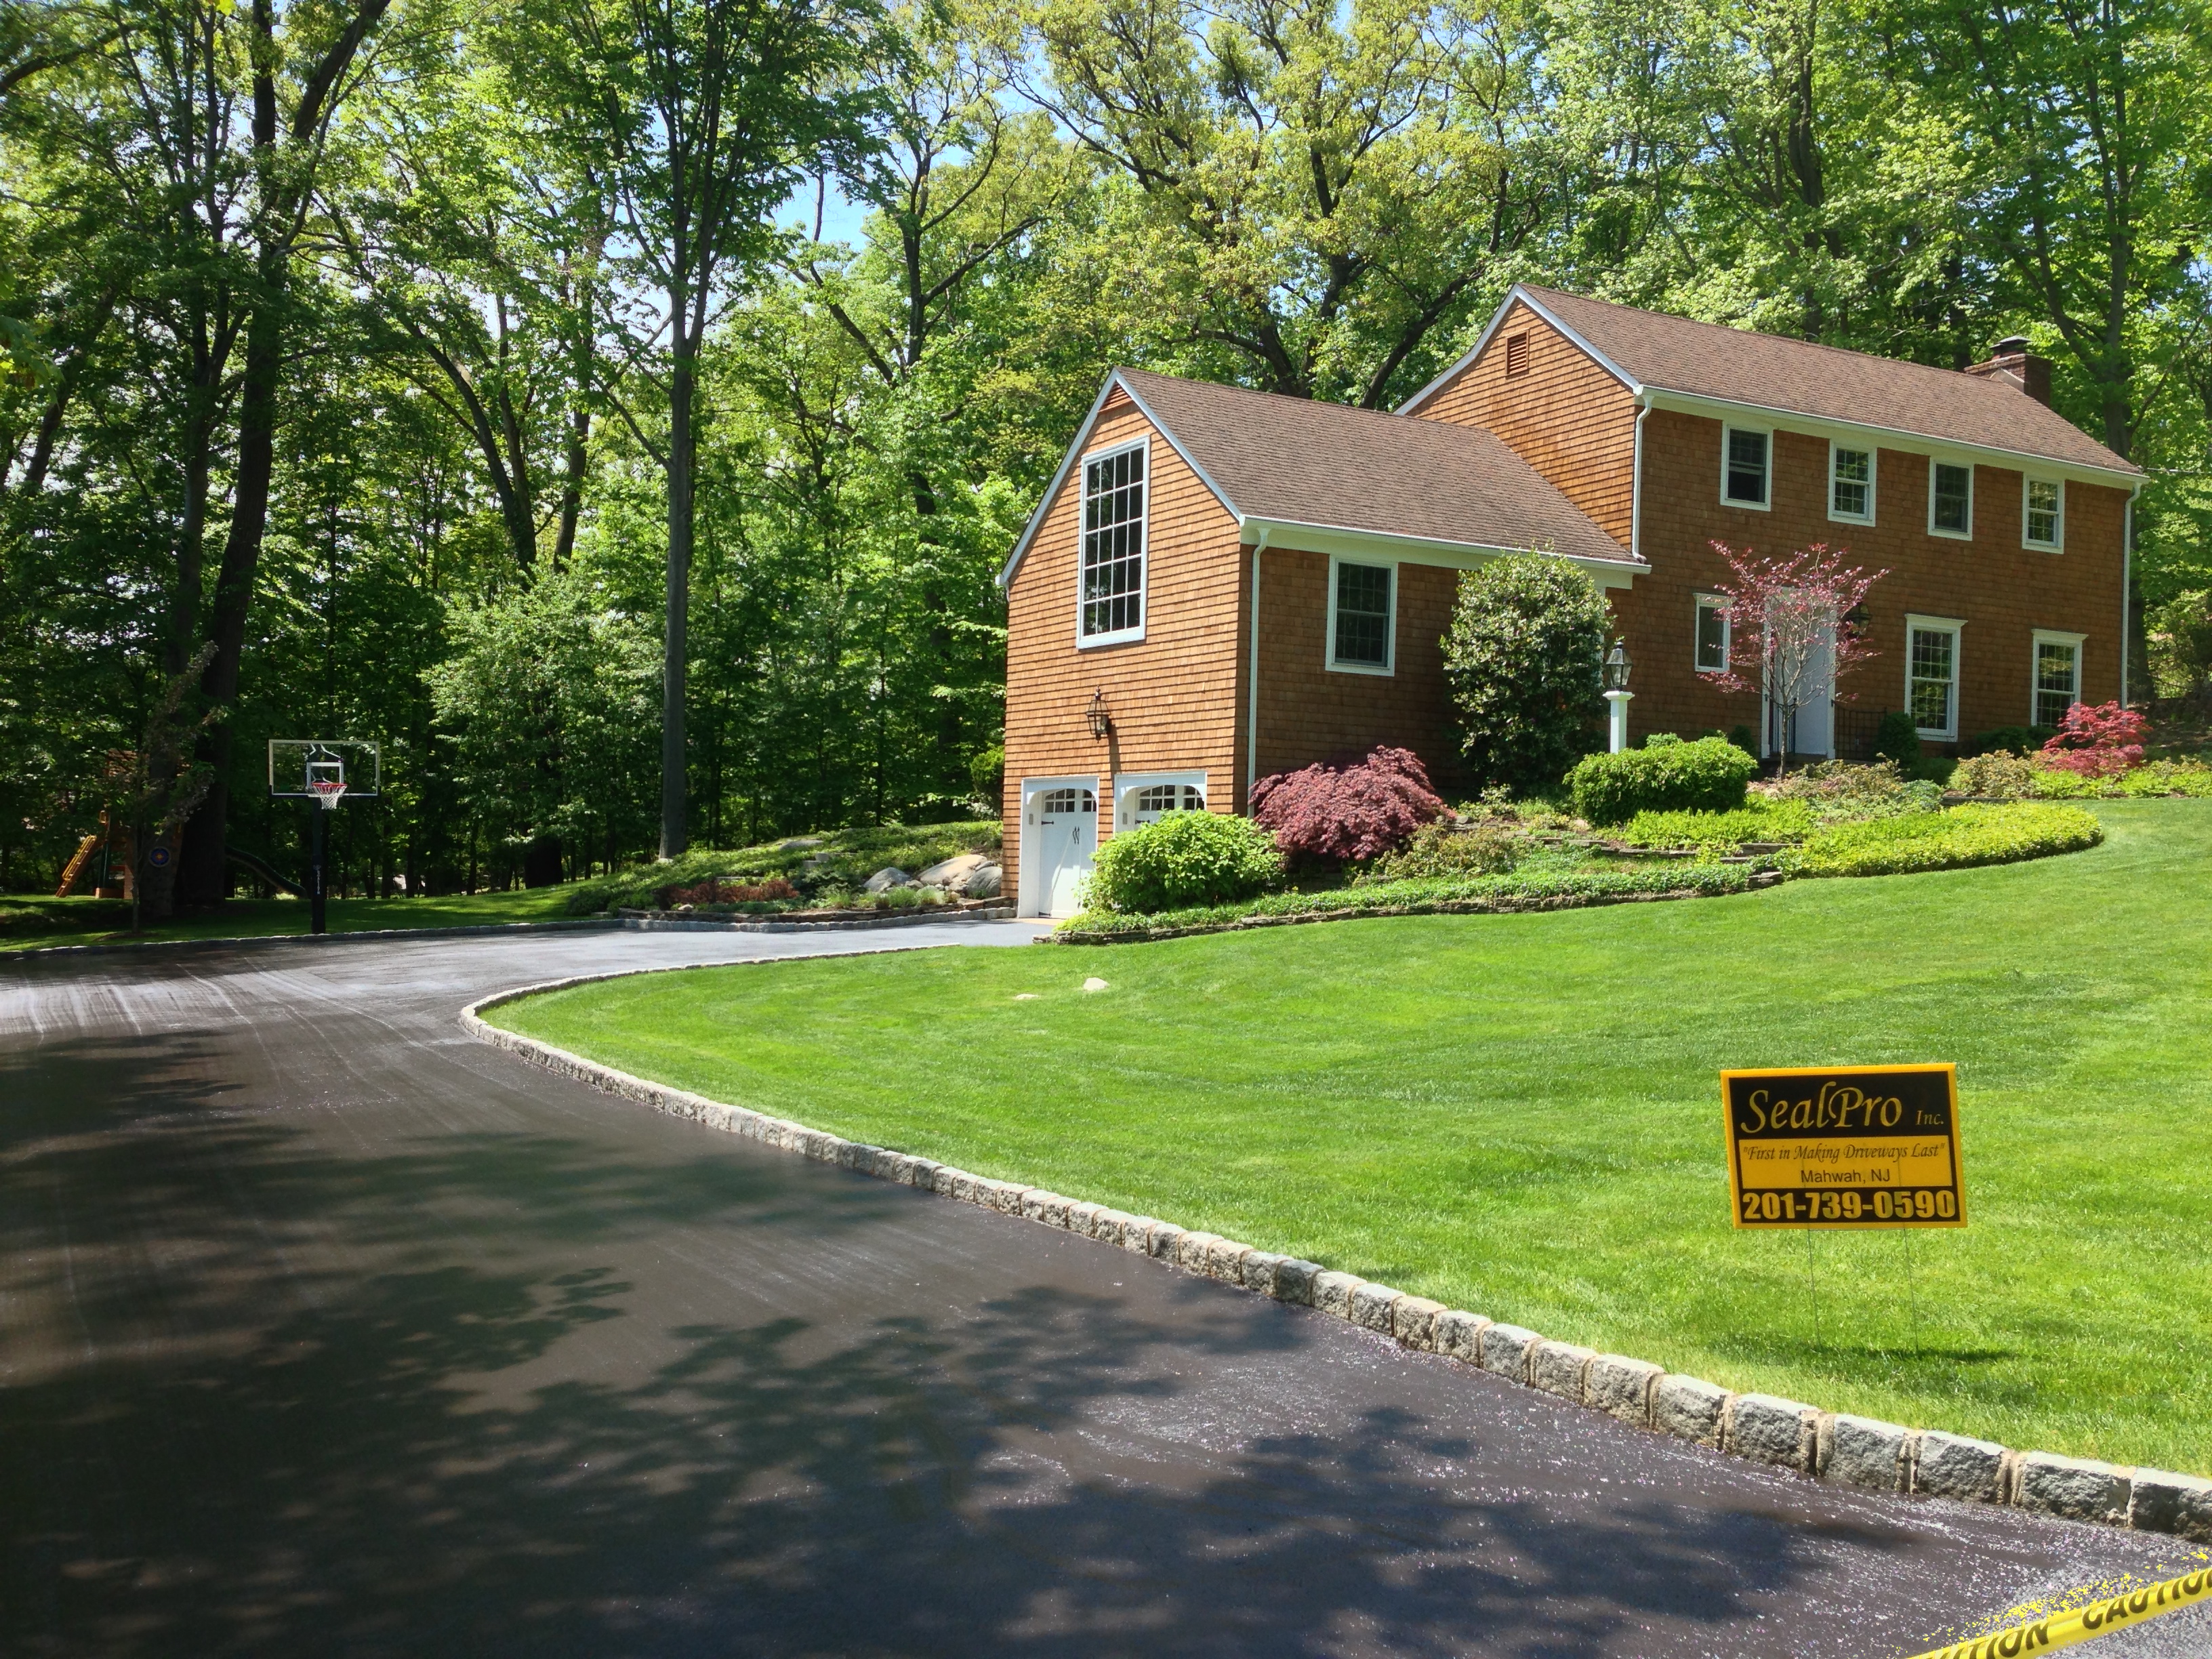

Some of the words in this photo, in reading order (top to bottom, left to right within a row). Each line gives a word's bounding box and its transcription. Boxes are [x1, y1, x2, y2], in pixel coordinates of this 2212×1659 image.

[1740, 1081, 1902, 1133] SealPro
[1914, 1109, 1944, 1126] Inc.
[1778, 1145, 1790, 1160] in
[1793, 1143, 1841, 1164] Making
[1843, 1144, 1908, 1163] Driveways
[1801, 1169, 1866, 1184] Mahwah,
[1871, 1168, 1891, 1183] NJ
[1742, 1189, 1956, 1220] 201-739-0590
